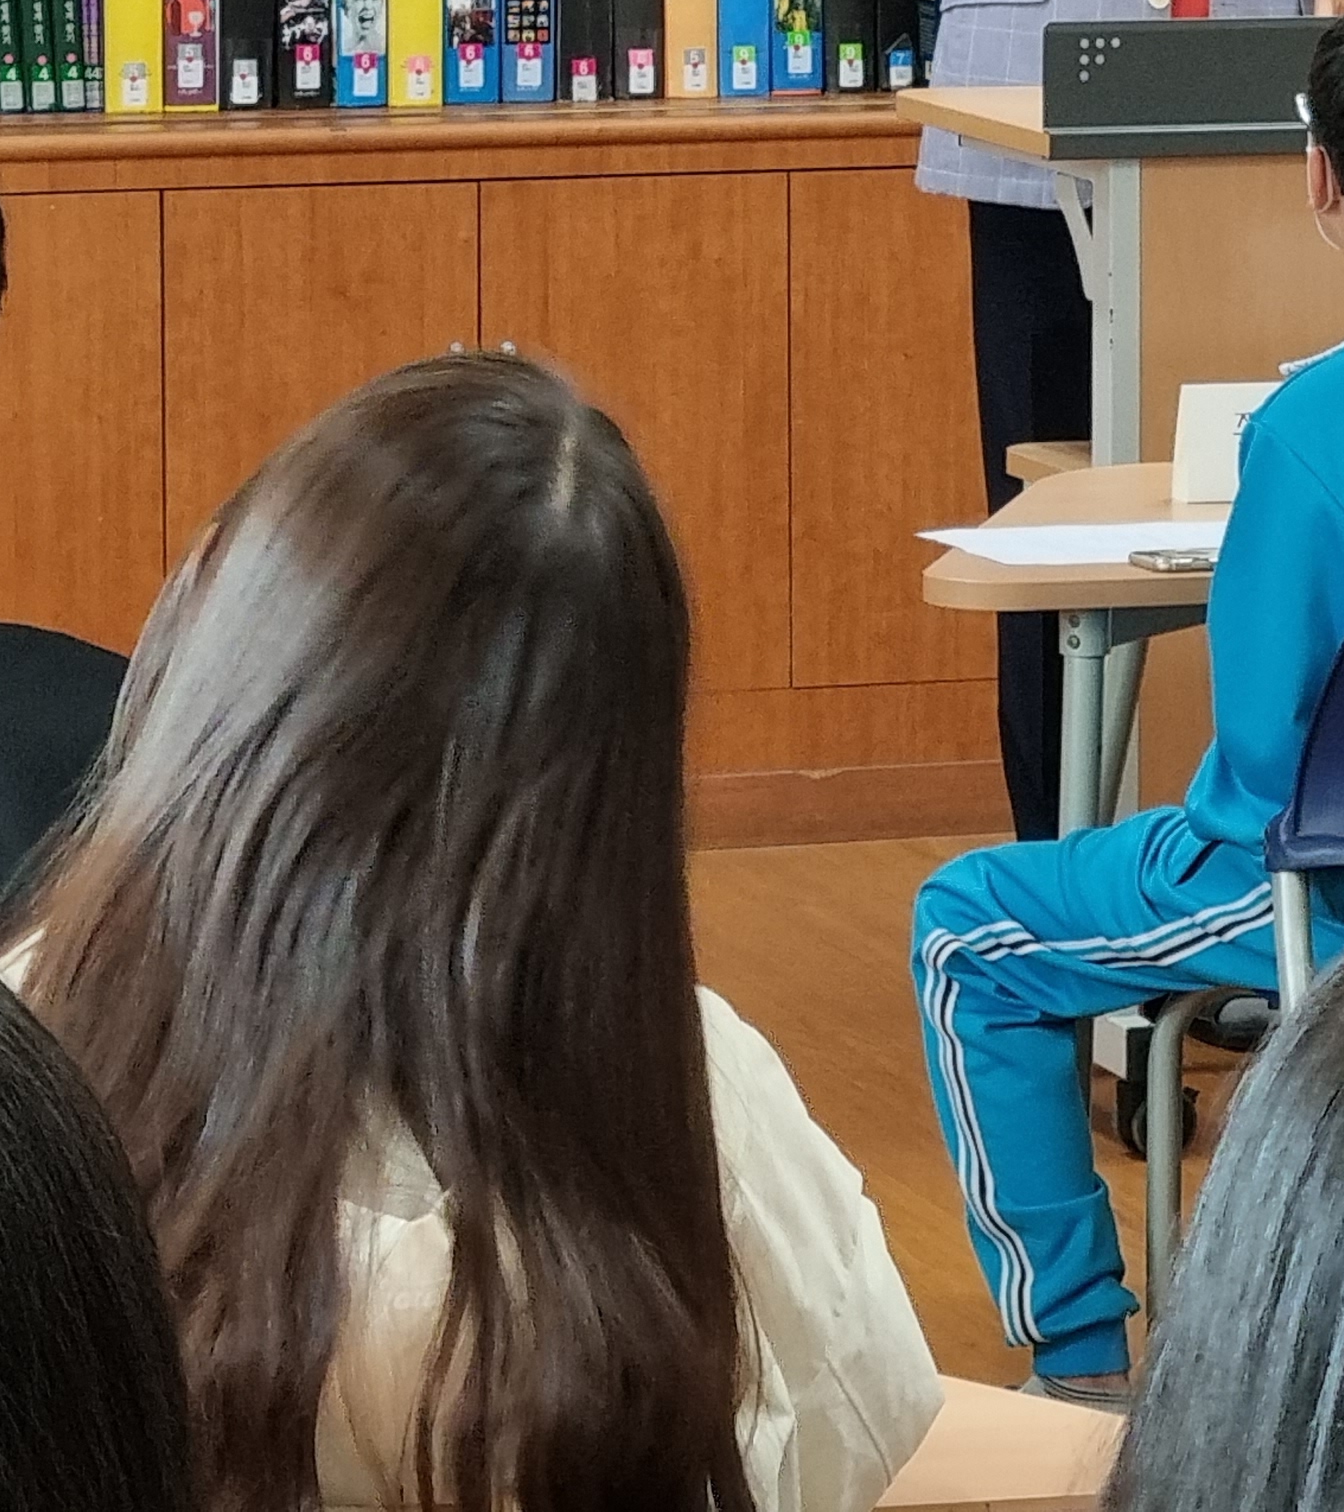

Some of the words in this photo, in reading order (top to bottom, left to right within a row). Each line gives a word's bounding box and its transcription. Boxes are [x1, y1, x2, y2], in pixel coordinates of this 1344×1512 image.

[302, 46, 313, 60] 6
[464, 44, 476, 60] 6
[896, 52, 906, 66] 7
[360, 53, 371, 69] 6
[578, 61, 589, 76] 6
[5, 66, 18, 81] 4
[38, 66, 50, 81] 4
[67, 65, 80, 79] 4
